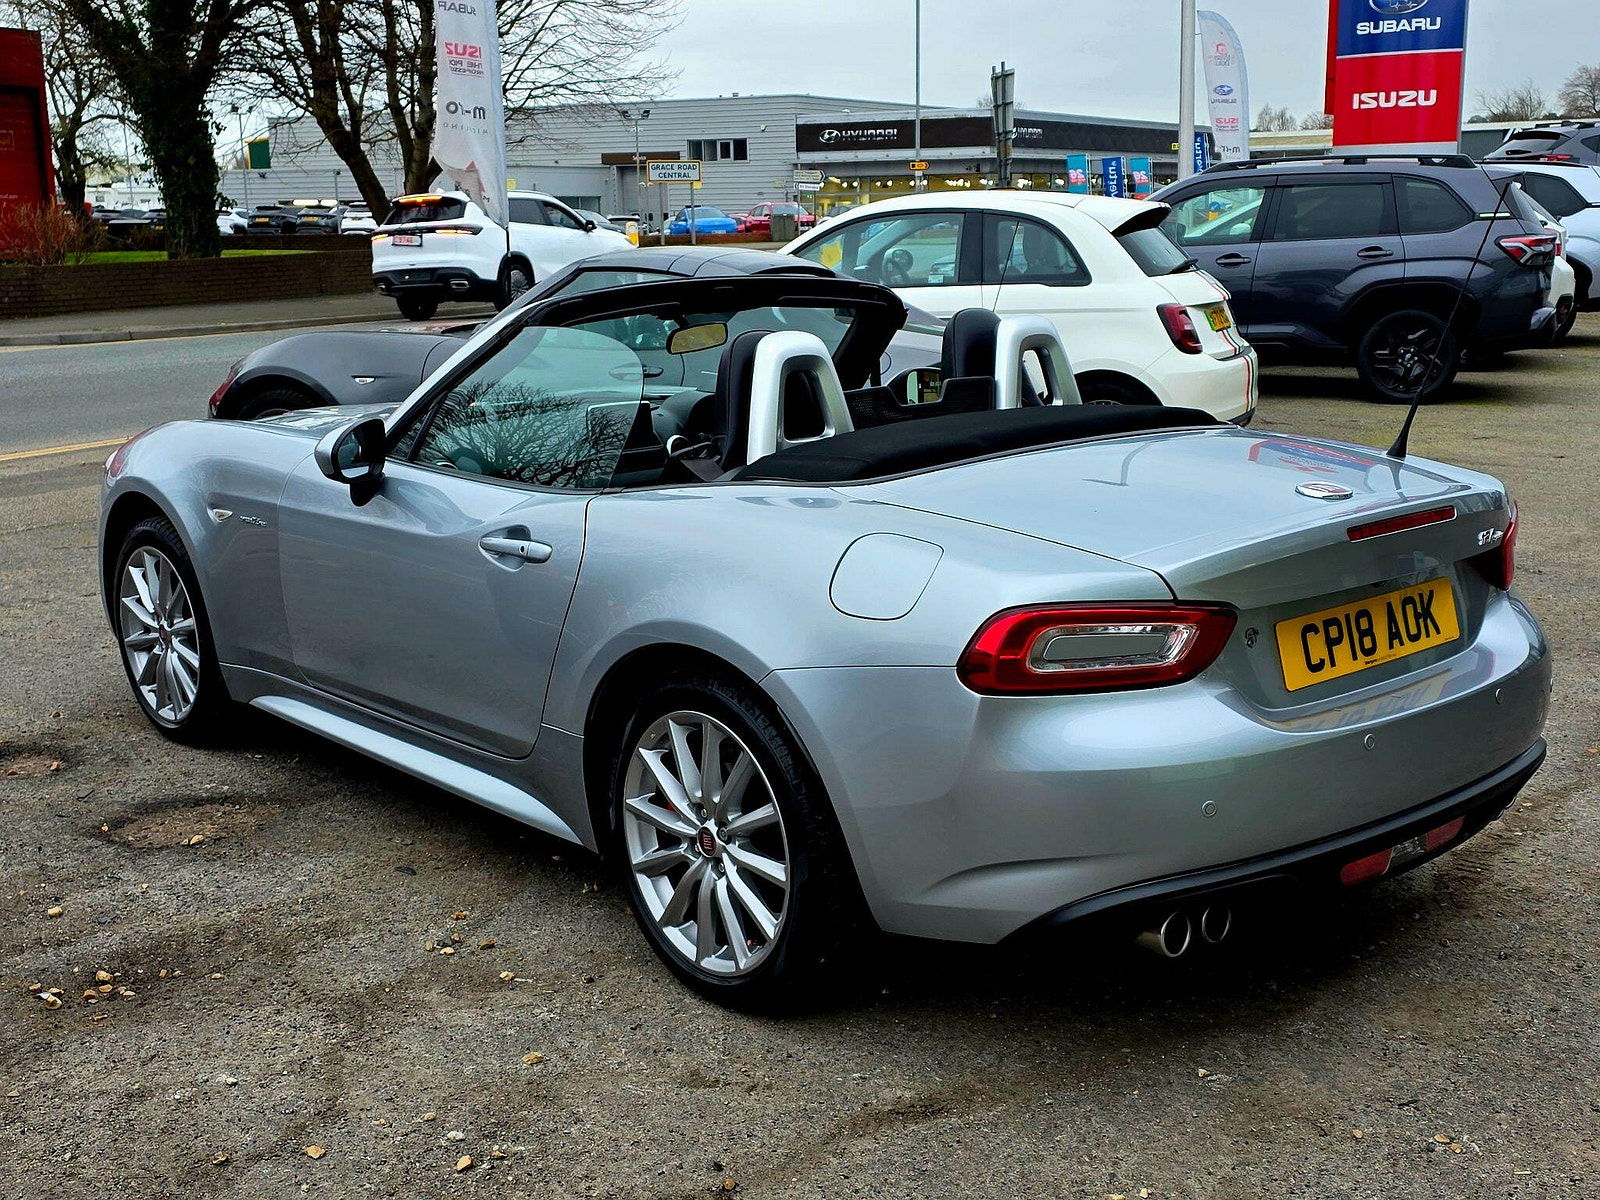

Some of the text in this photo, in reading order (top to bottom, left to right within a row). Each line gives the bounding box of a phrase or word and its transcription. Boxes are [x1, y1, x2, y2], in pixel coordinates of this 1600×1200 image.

[1356, 17, 1441, 35] SUBARU
[1352, 89, 1438, 110] ISUZU
[842, 128, 898, 141] HYUNDAI
[650, 163, 698, 171] GRACE ROAD
[1300, 589, 1442, 674] CP18 AOK
